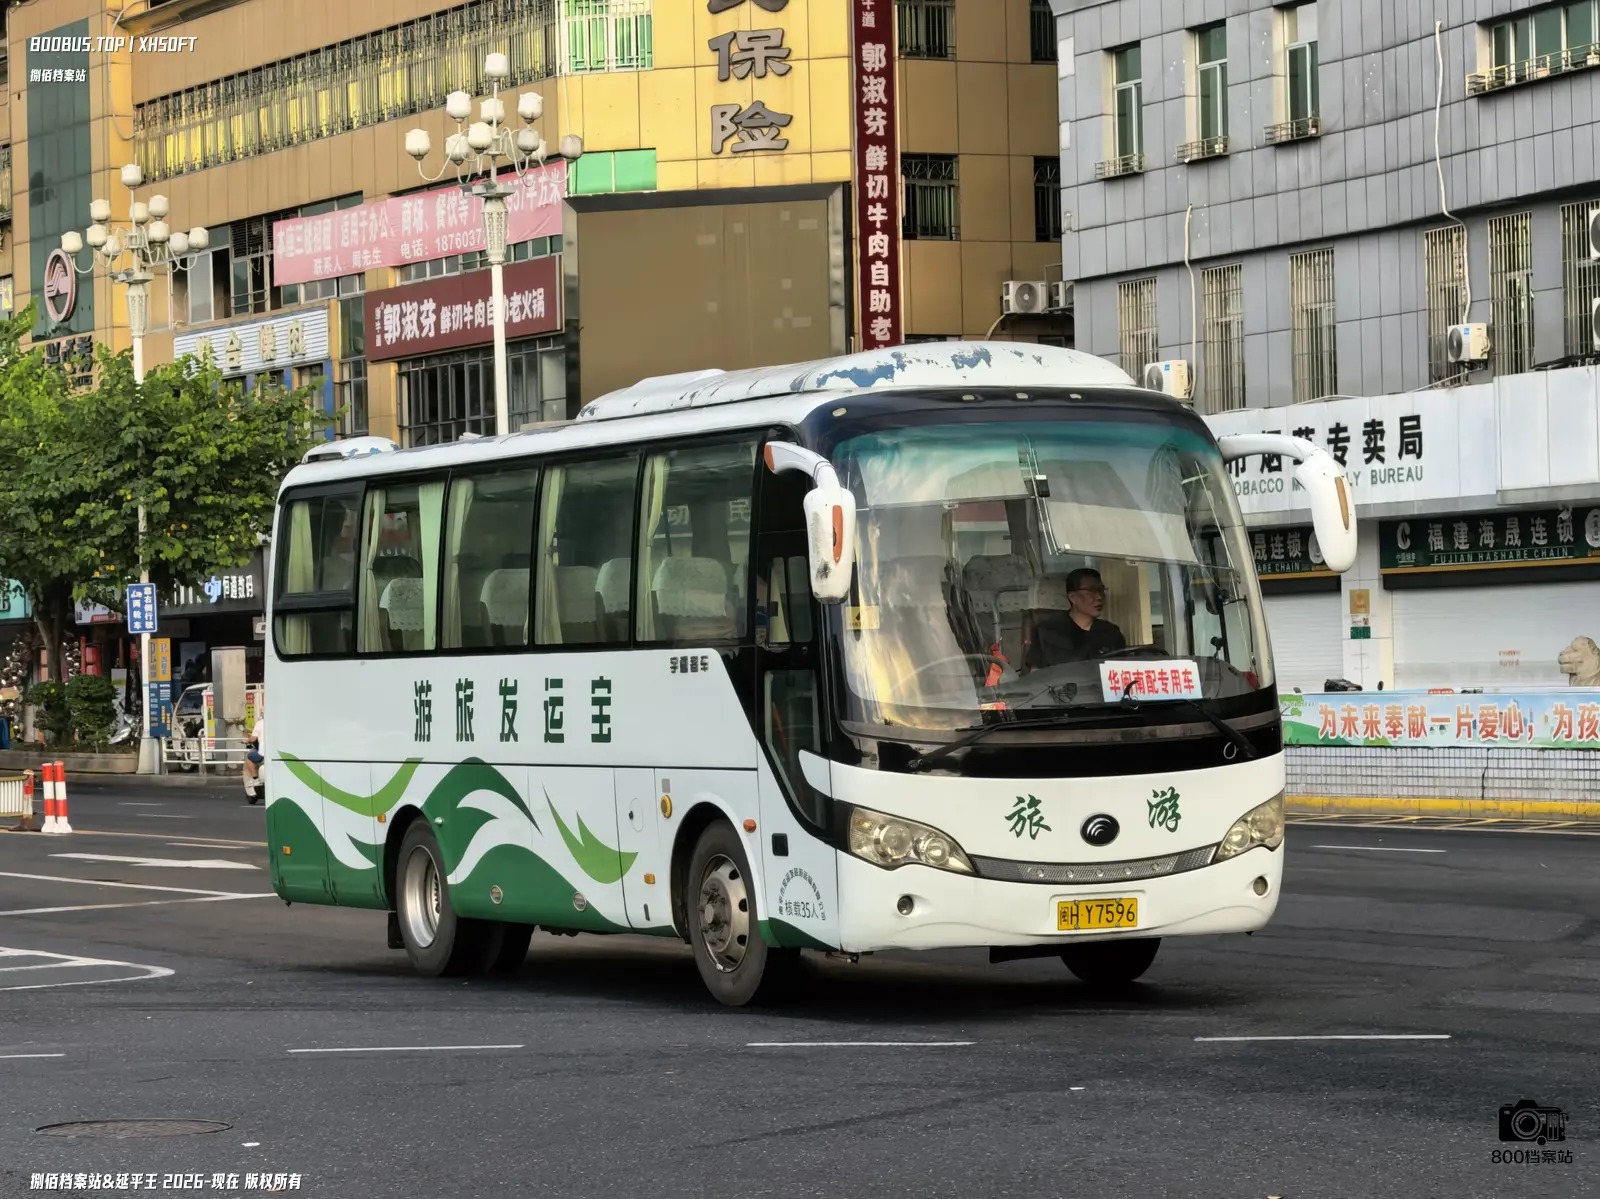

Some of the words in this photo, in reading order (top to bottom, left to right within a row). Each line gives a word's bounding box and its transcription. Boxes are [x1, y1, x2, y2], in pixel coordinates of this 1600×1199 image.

[707, 0, 794, 154] 保险
[384, 297, 437, 345] 郭淑芬
[1234, 478, 1284, 496] OBACCO
[1370, 465, 1423, 485] BUREAU
[1428, 503, 1574, 552] 福建海晟连锁
[1256, 564, 1272, 574] ARE
[1275, 562, 1300, 573] CHAIN
[1434, 553, 1473, 564] FUJIAN
[1478, 549, 1529, 562] HASHARE
[1533, 547, 1569, 560] CHAIN
